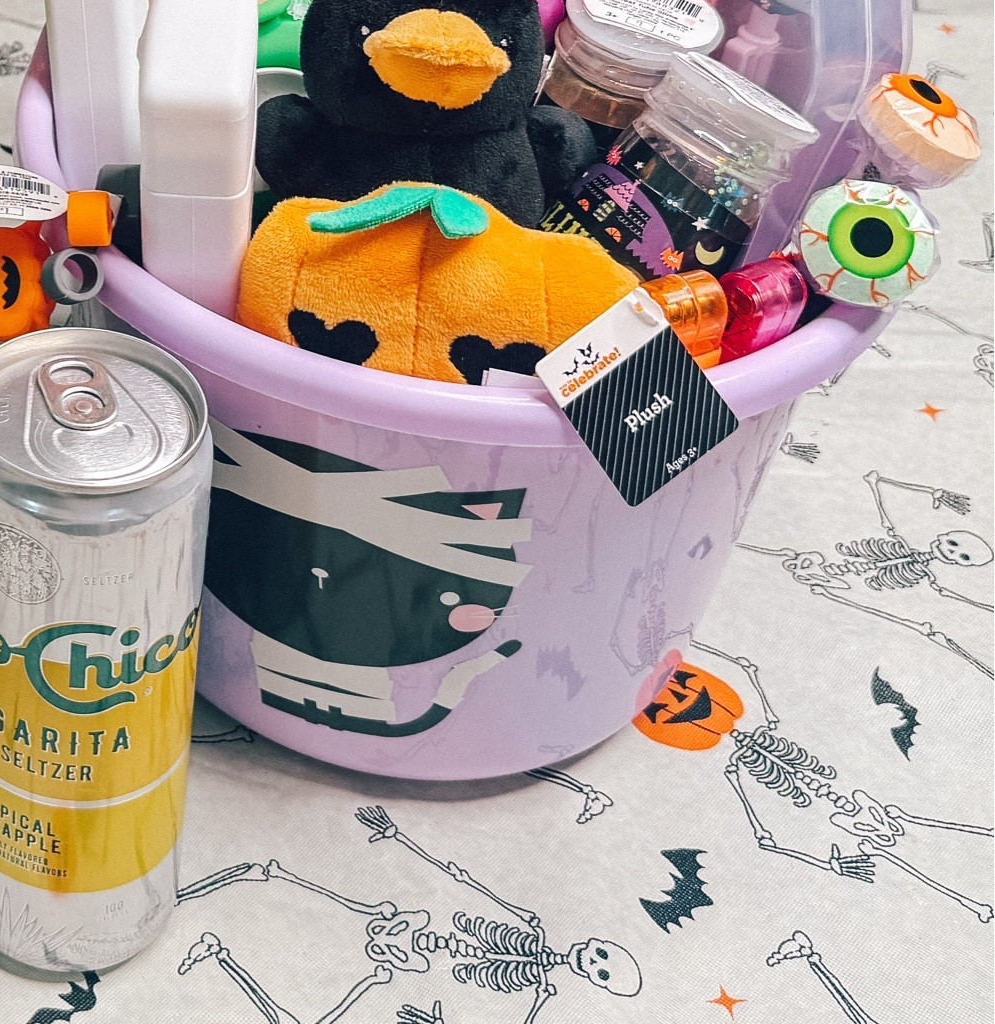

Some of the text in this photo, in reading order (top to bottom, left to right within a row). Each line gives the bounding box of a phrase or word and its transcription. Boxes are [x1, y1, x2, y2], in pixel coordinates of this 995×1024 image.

[561, 347, 622, 398] celebrate!
[624, 392, 673, 433] Plush
[665, 454, 688, 474] Ages
[83, 571, 134, 586] SELTZER
[24, 607, 199, 715] Chico
[1, 744, 93, 781] SELTZER
[9, 845, 49, 866] FLAVORED
[31, 863, 68, 877] FLAVORS
